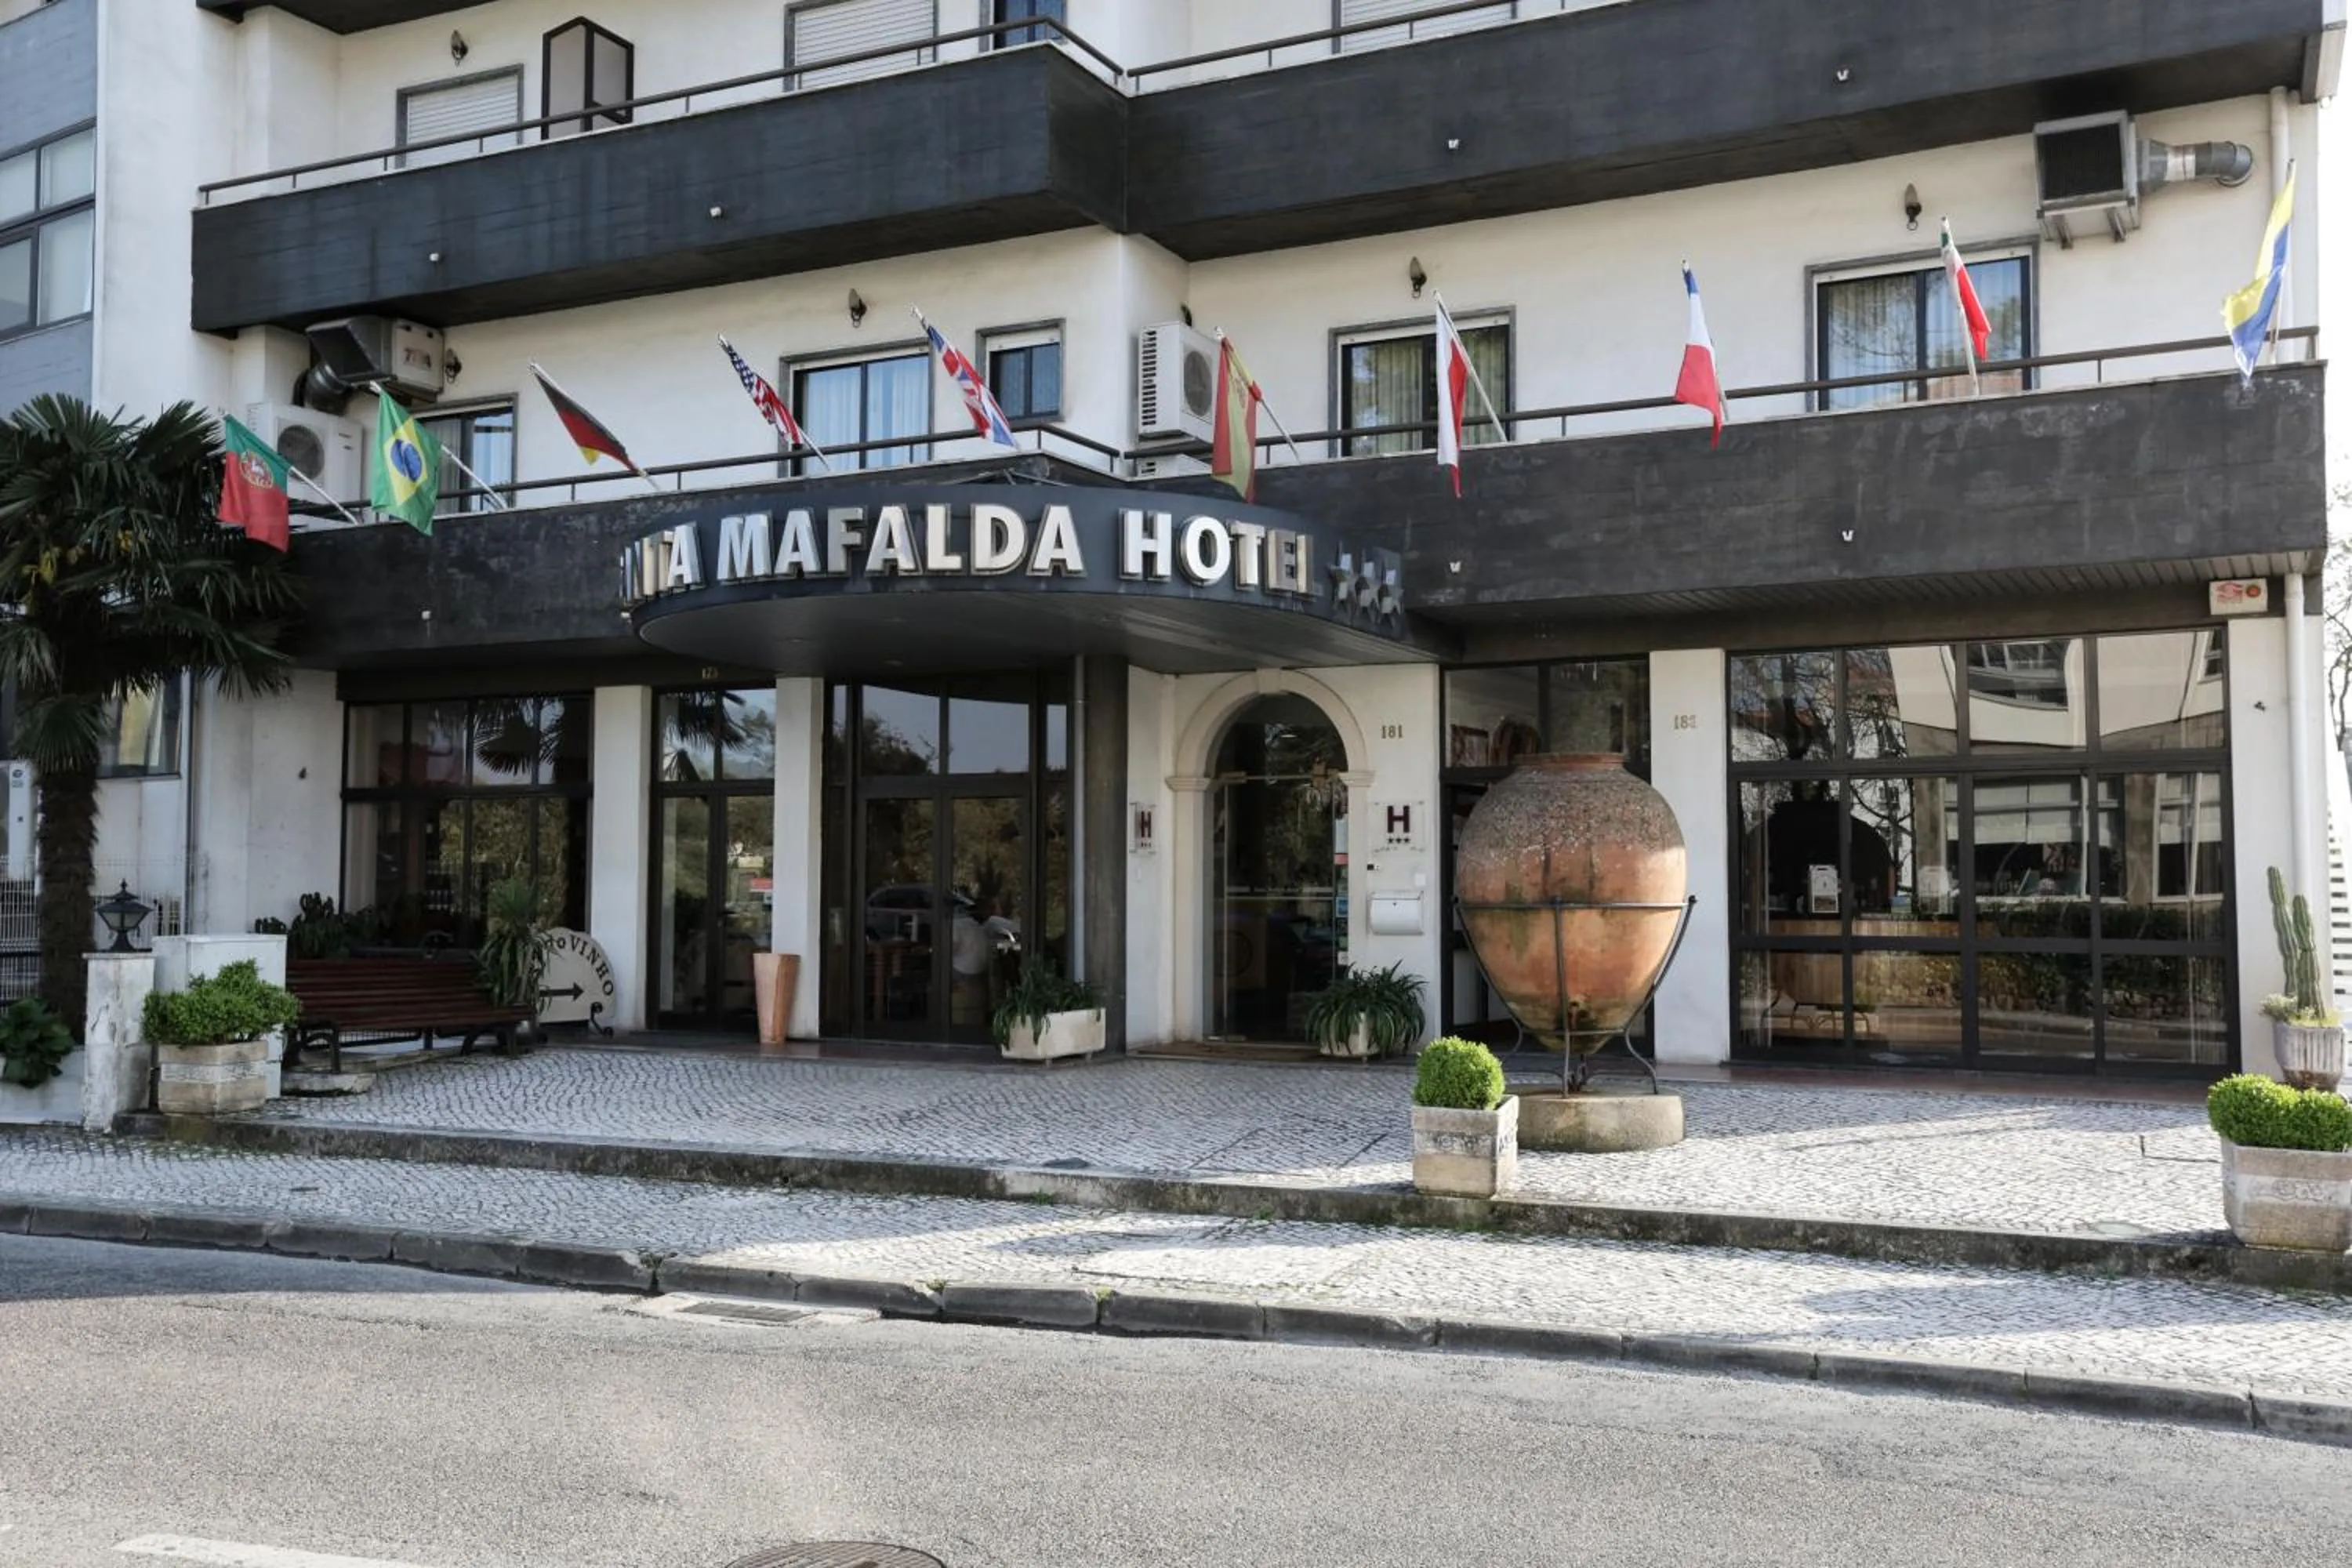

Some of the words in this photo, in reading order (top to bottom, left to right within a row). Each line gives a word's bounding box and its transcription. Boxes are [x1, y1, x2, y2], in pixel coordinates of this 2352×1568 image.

[717, 503, 1087, 580] MAFALDA
[1119, 508, 1320, 601] HOTEL
[1381, 724, 1403, 739] 181
[1141, 810, 1152, 838] H
[1386, 805, 1410, 833] H
